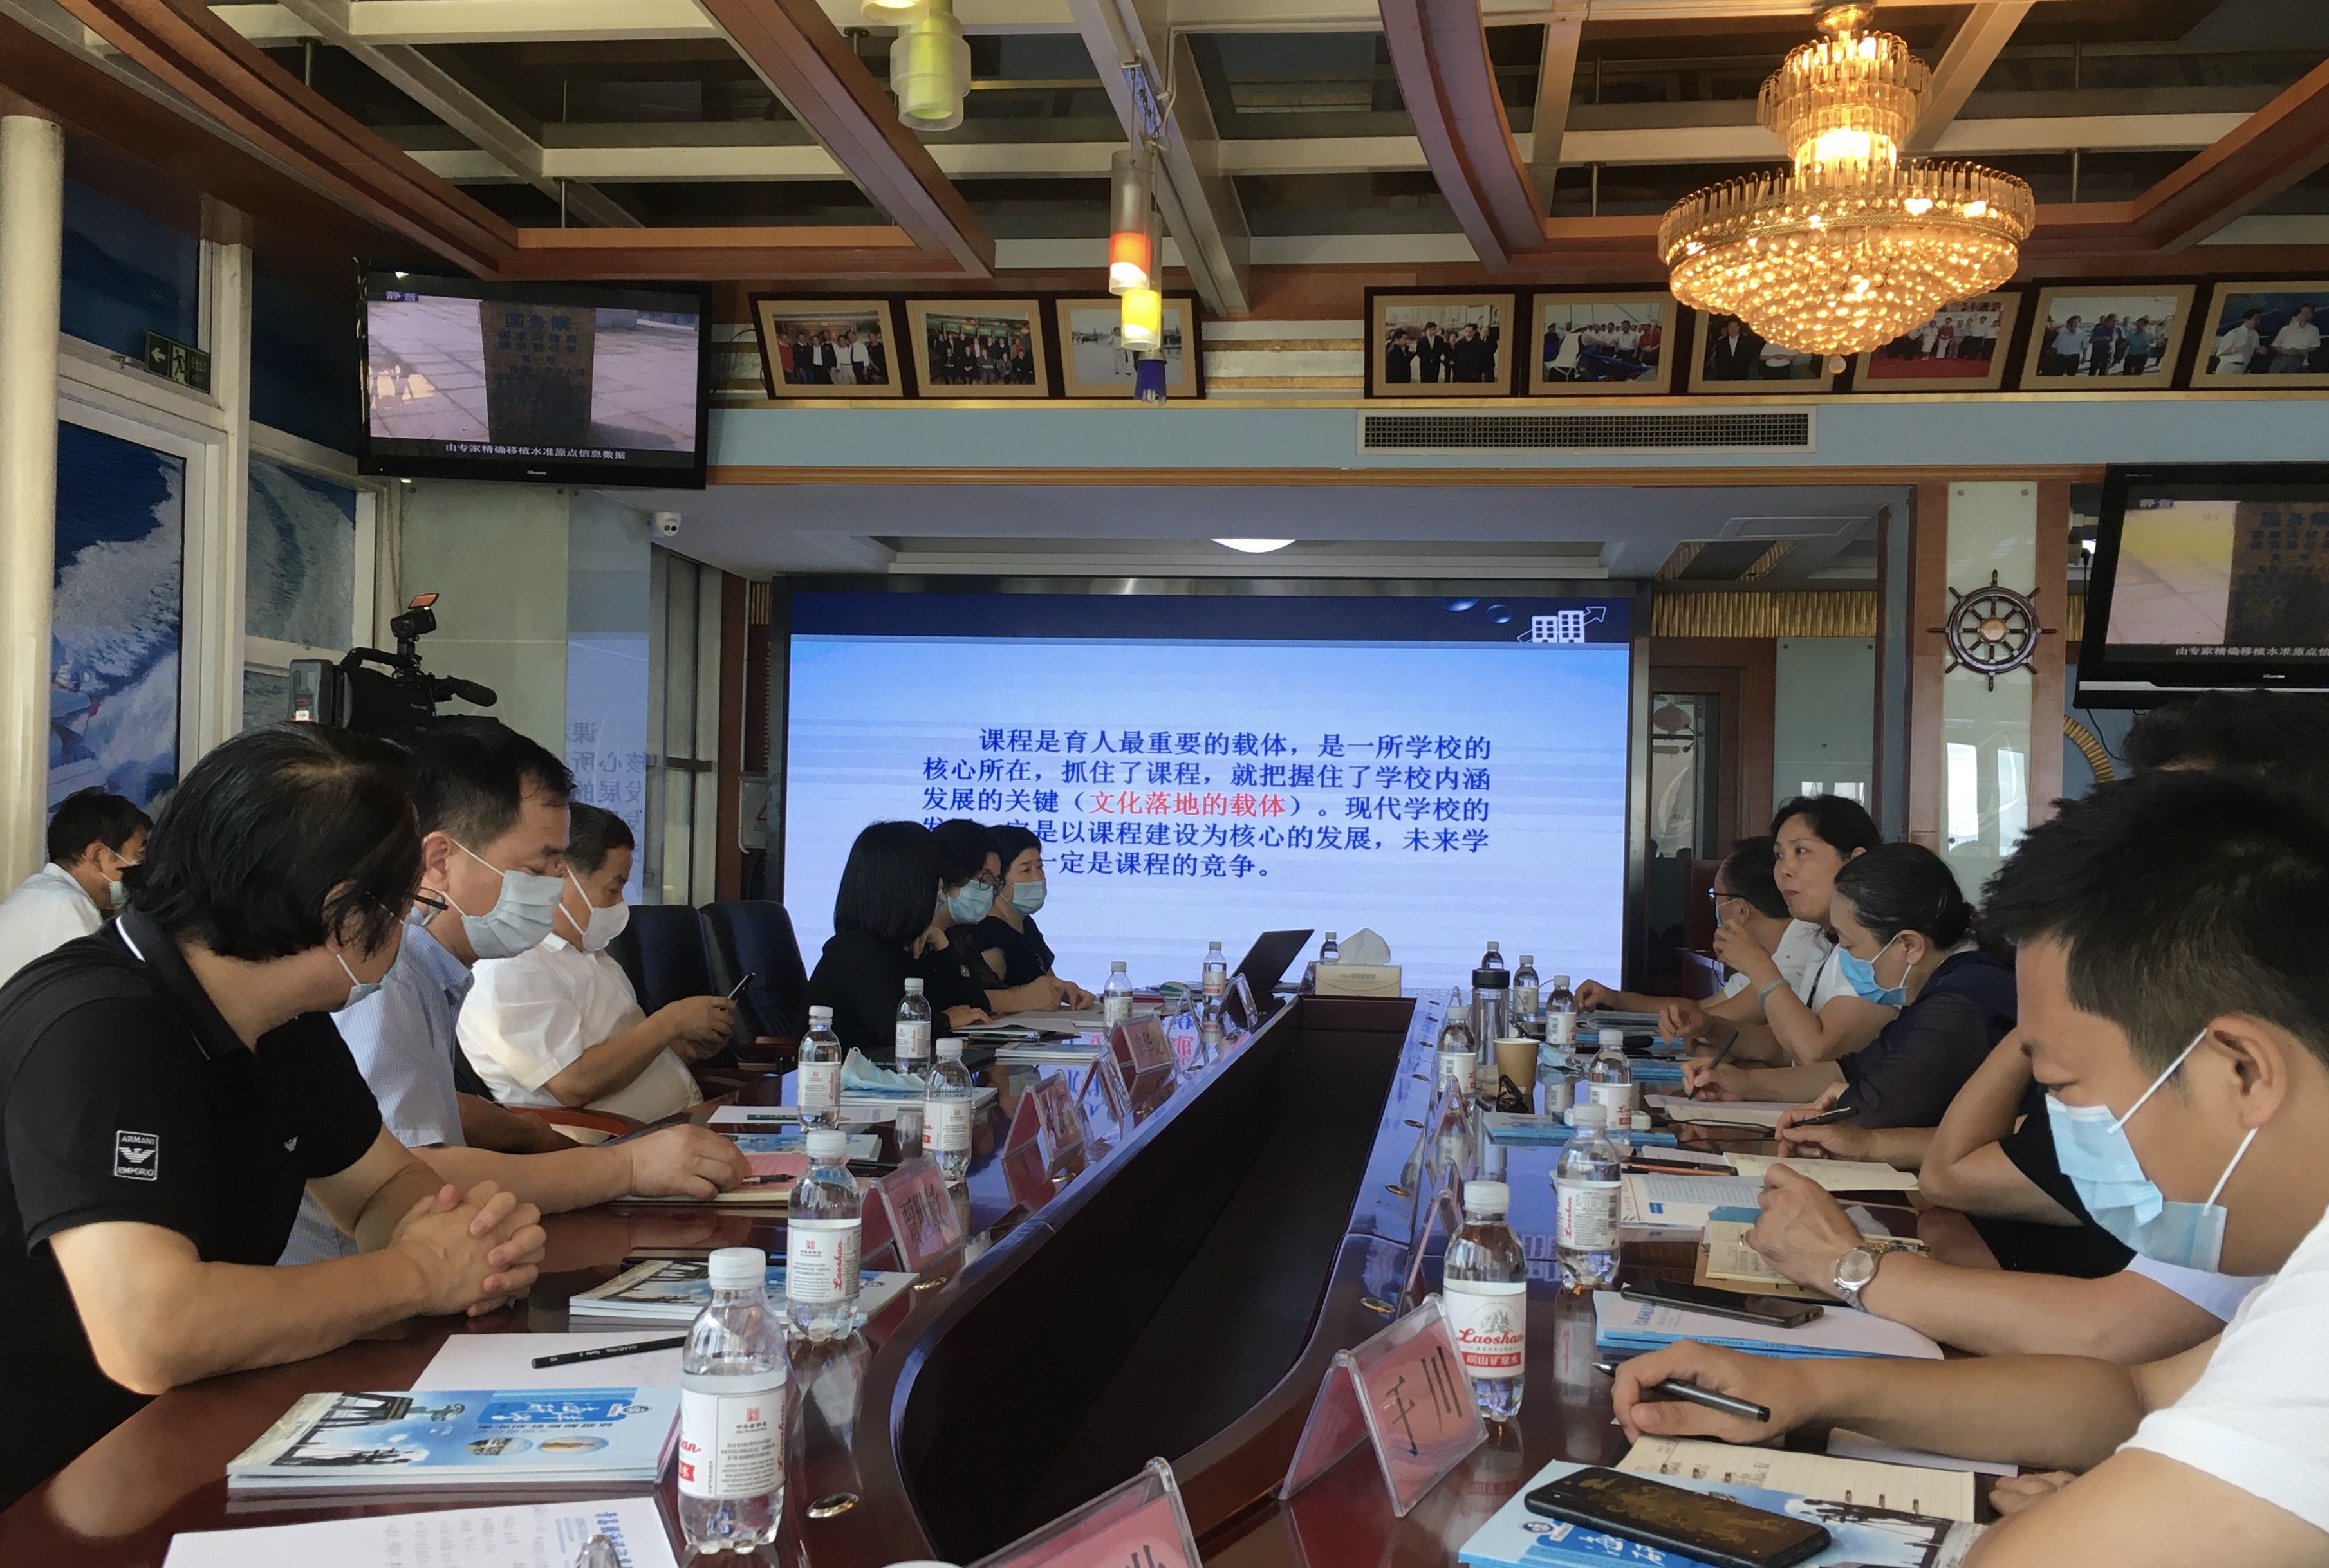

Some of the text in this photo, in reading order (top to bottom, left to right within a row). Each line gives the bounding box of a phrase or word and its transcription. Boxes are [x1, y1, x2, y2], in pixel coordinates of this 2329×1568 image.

[445, 443, 626, 459] 由专家精确移植水准原点信息数据
[979, 728, 1491, 761] 课程是育人最重要的载体，是一所学校的
[923, 757, 1490, 791] 核心所在，抓住了课程，就把握住了学校内涵
[120, 1135, 154, 1145] ARMANI
[118, 1167, 154, 1176] EMPORIO
[833, 1239, 843, 1291] Laoshan
[1456, 1327, 1525, 1345] Laoshan
[1466, 1354, 1519, 1365] 崂山矿泉水
